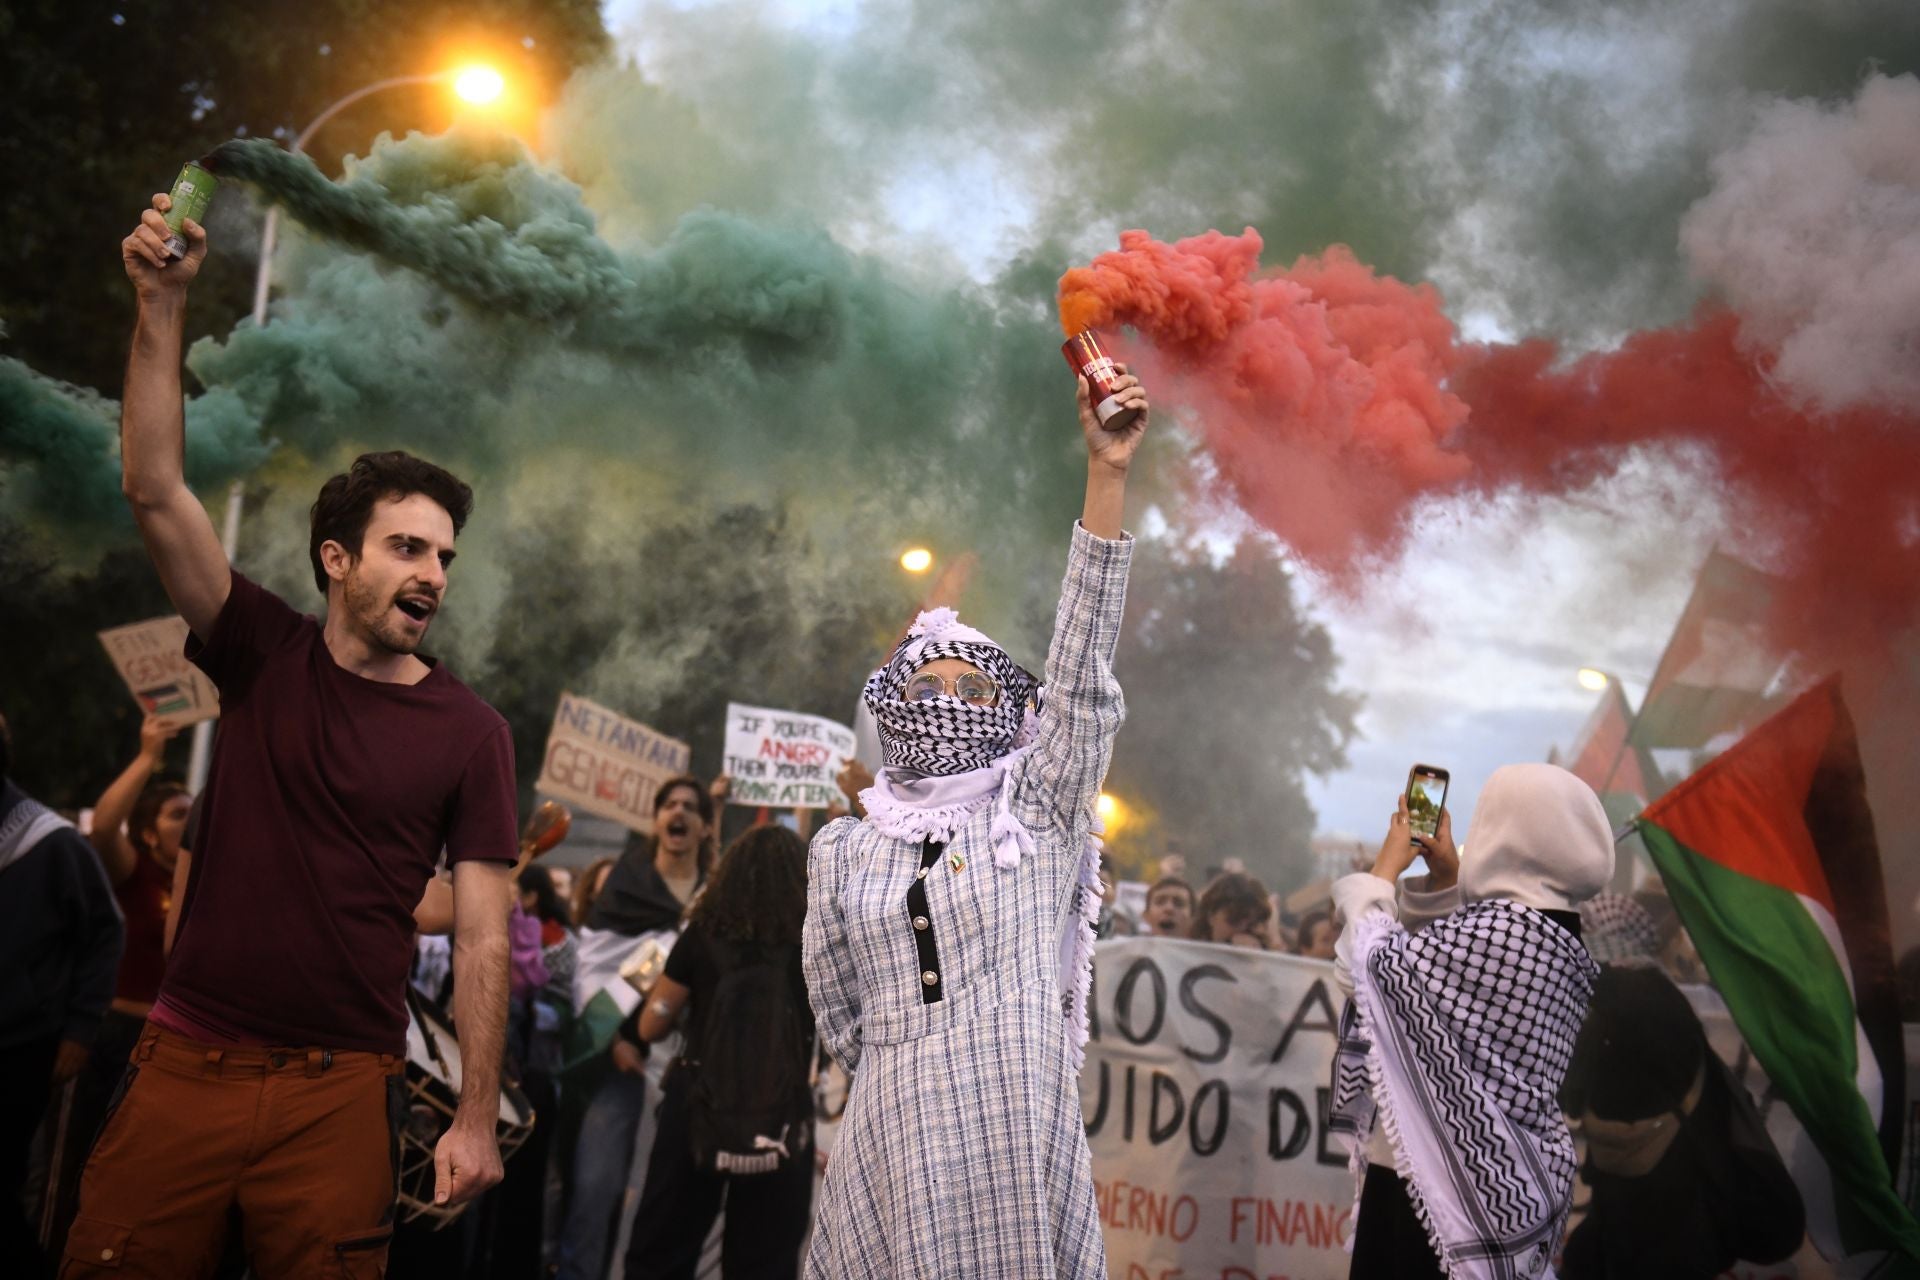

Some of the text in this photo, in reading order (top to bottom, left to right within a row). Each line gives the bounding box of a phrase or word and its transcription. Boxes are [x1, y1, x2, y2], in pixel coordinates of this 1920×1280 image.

[559, 699, 690, 775] NETANYAHU
[738, 715, 765, 734] IF
[727, 756, 767, 777] THEN
[757, 738, 831, 767] ANGRY
[1088, 957, 1237, 1064] OS
